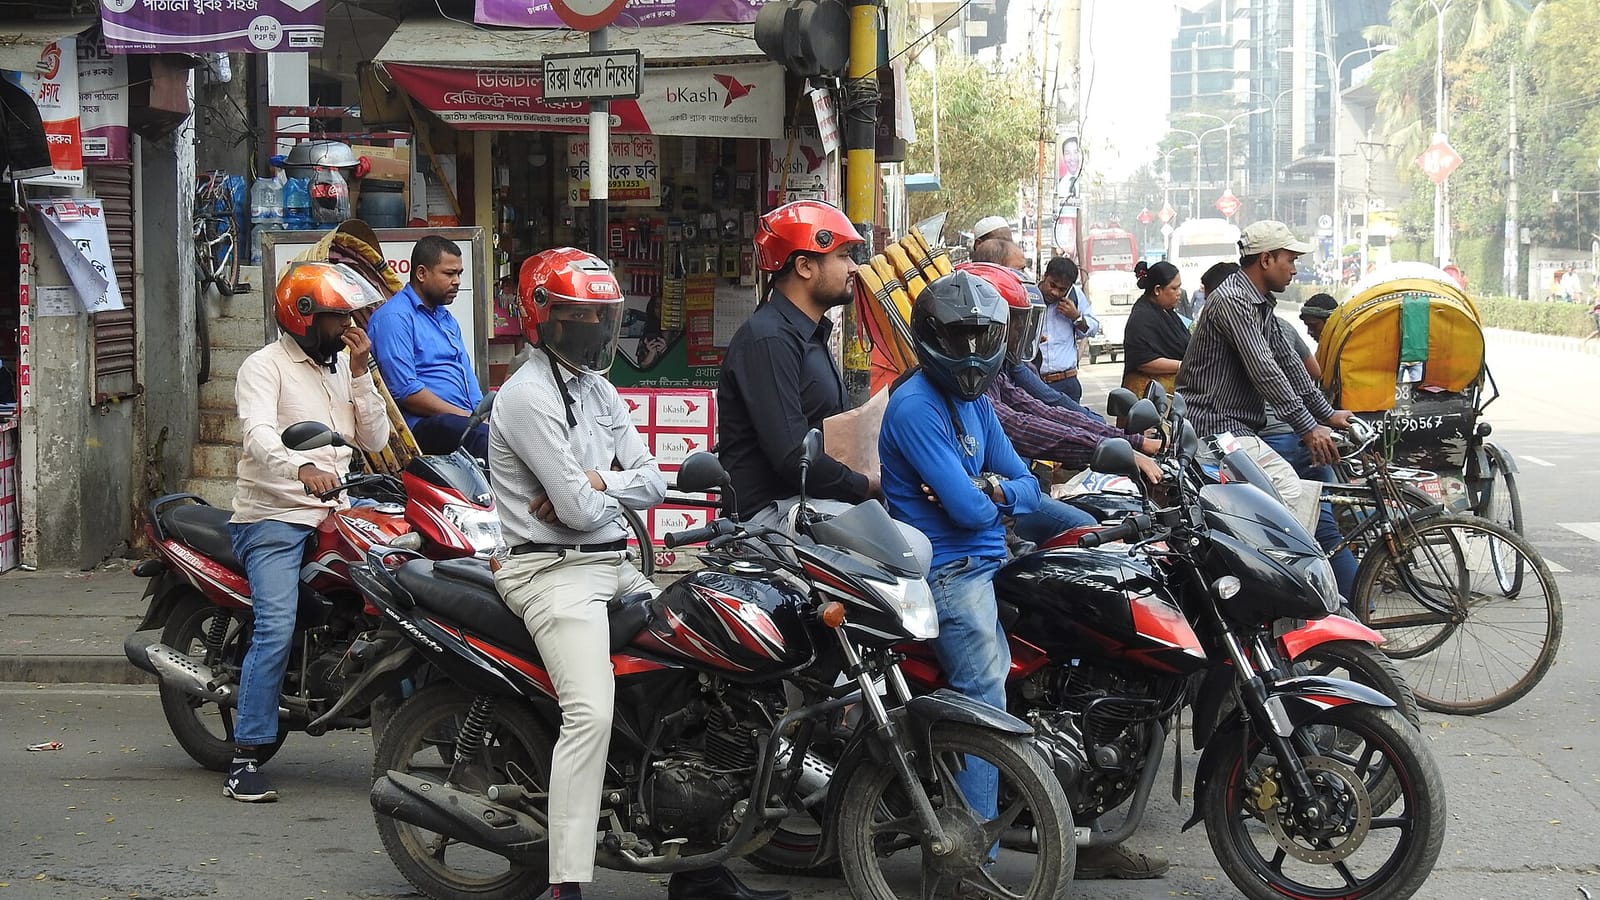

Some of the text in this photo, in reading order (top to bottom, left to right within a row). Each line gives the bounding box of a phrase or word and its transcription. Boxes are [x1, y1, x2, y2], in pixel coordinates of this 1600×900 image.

[254, 24, 269, 33] App
[545, 58, 637, 92] রিক্সা প্রবেশ নিষেধ
[666, 87, 718, 103] bKash
[634, 160, 658, 182] ছবি
[608, 180, 640, 188] 6931253
